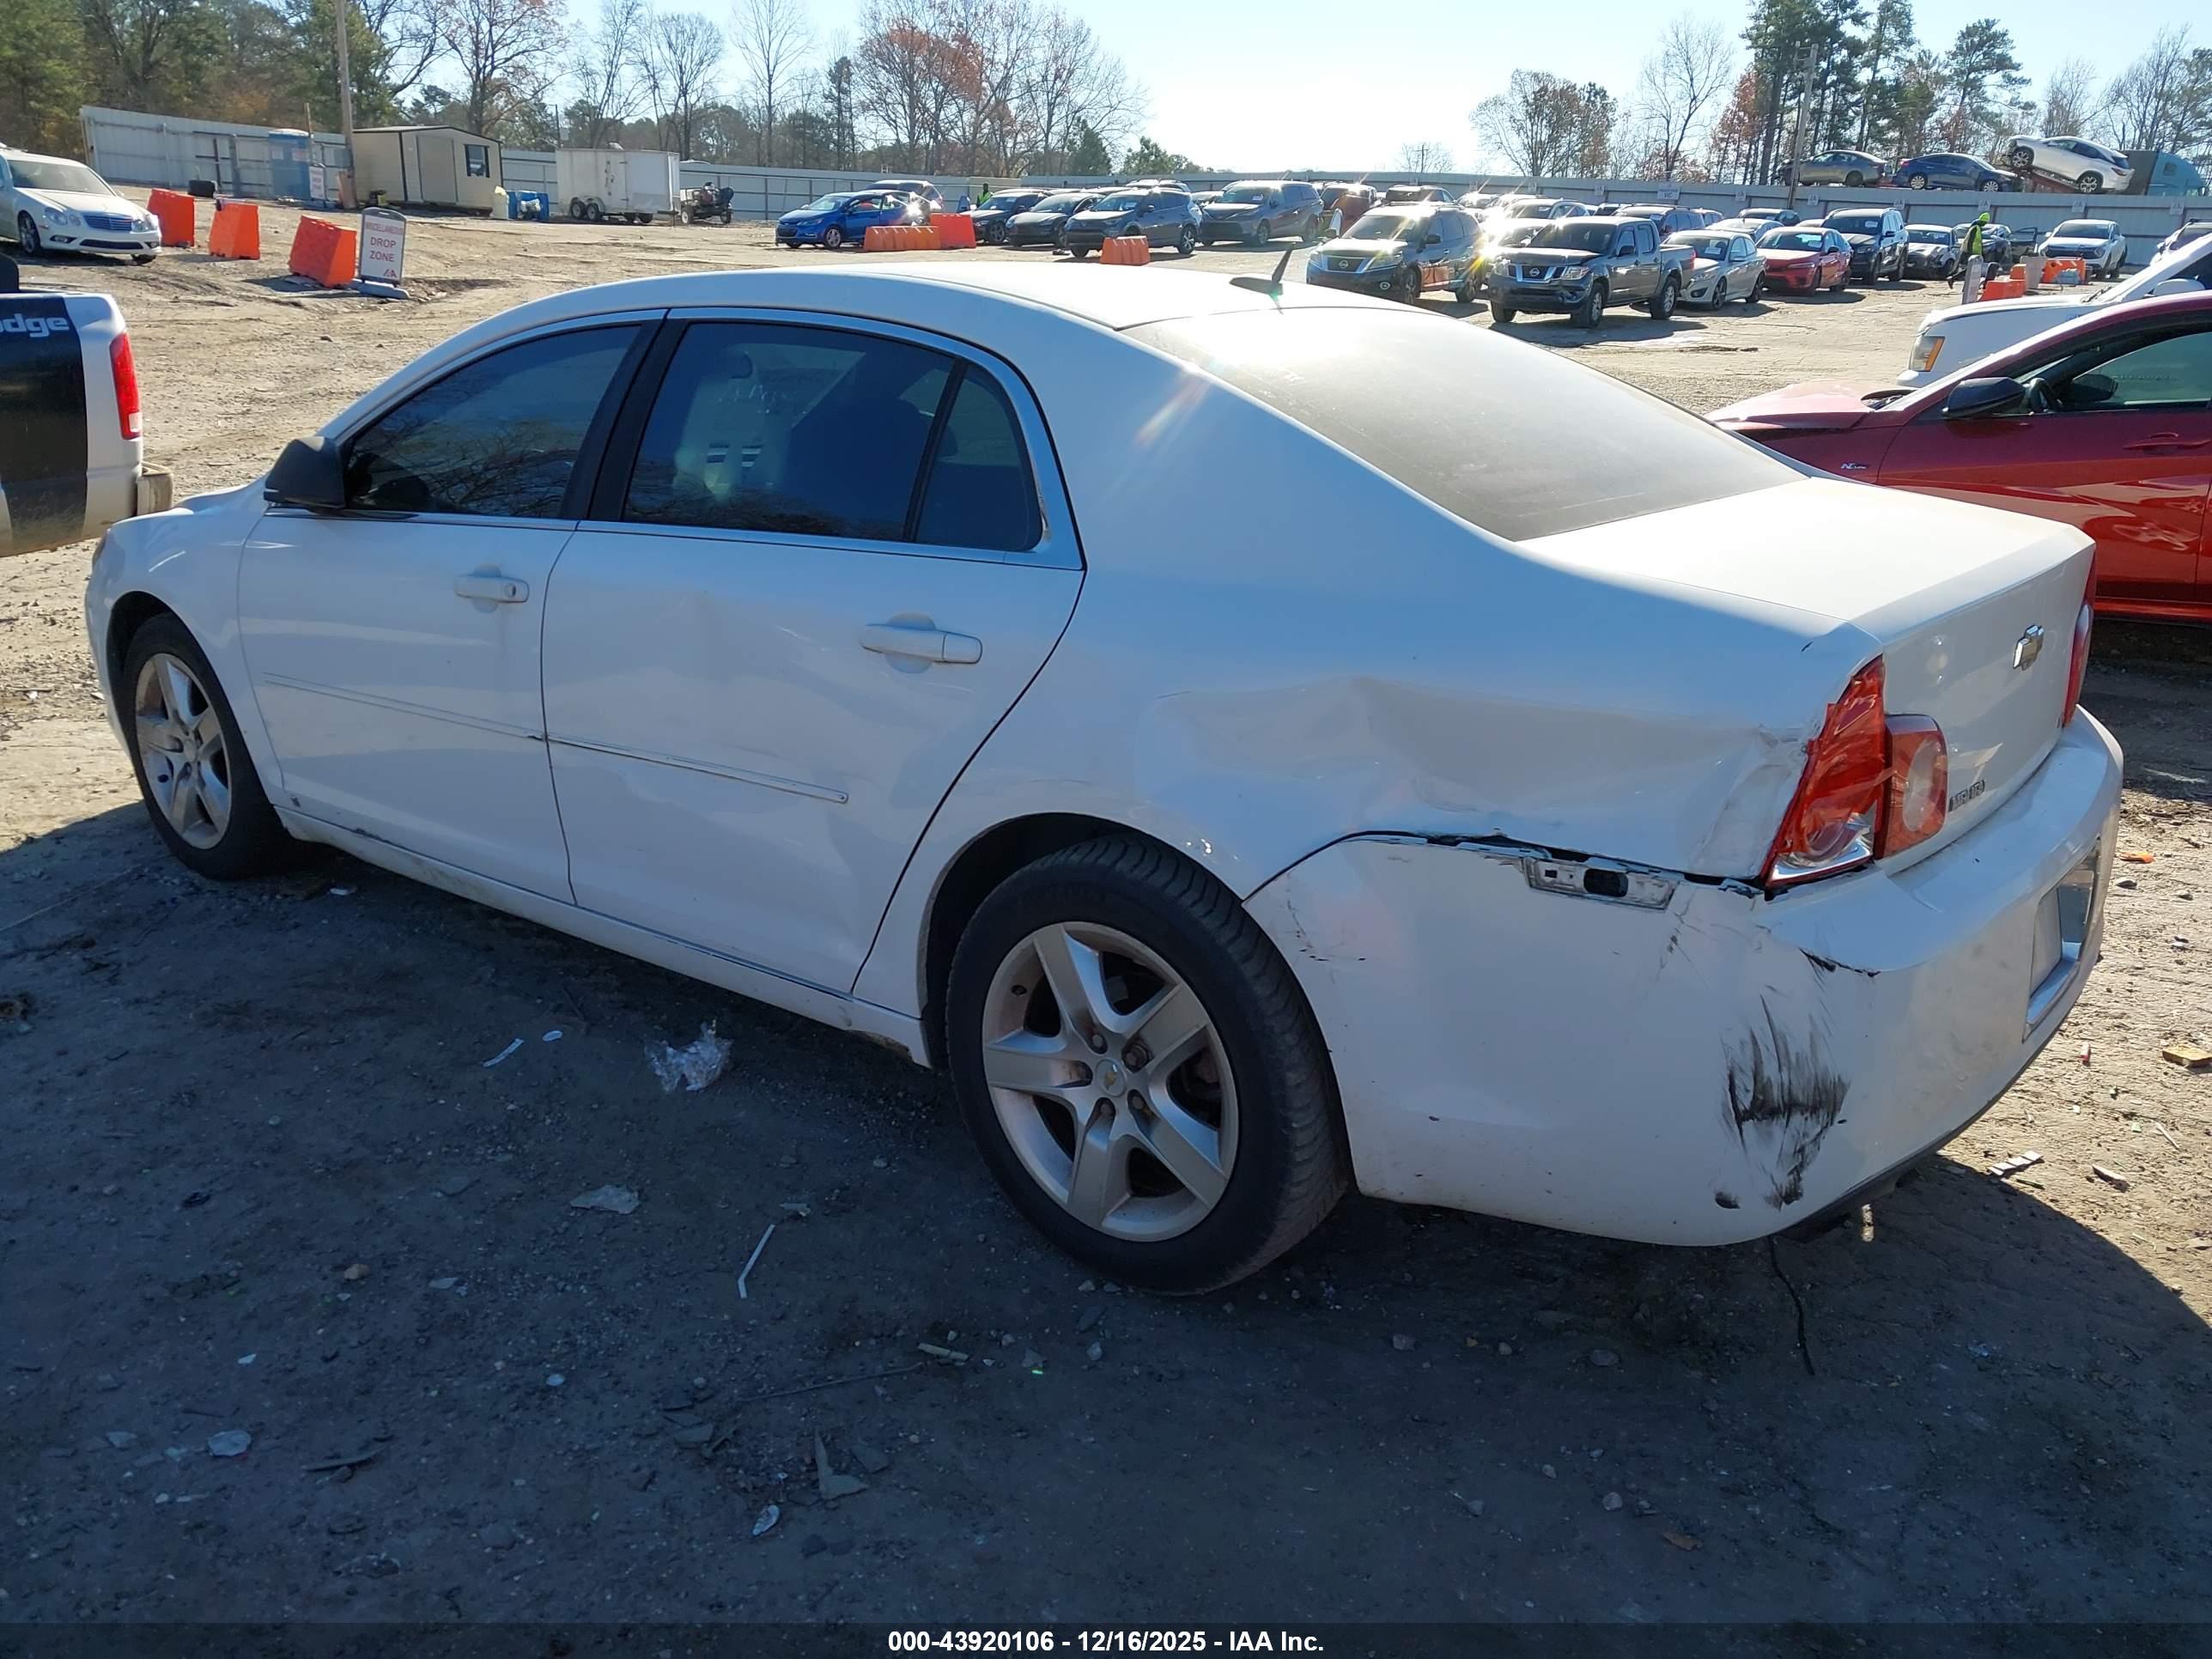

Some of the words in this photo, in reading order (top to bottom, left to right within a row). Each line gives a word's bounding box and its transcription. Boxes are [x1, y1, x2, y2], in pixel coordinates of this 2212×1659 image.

[370, 236, 397, 248] DROP
[369, 250, 395, 262] ZONE
[0, 313, 70, 337] dge
